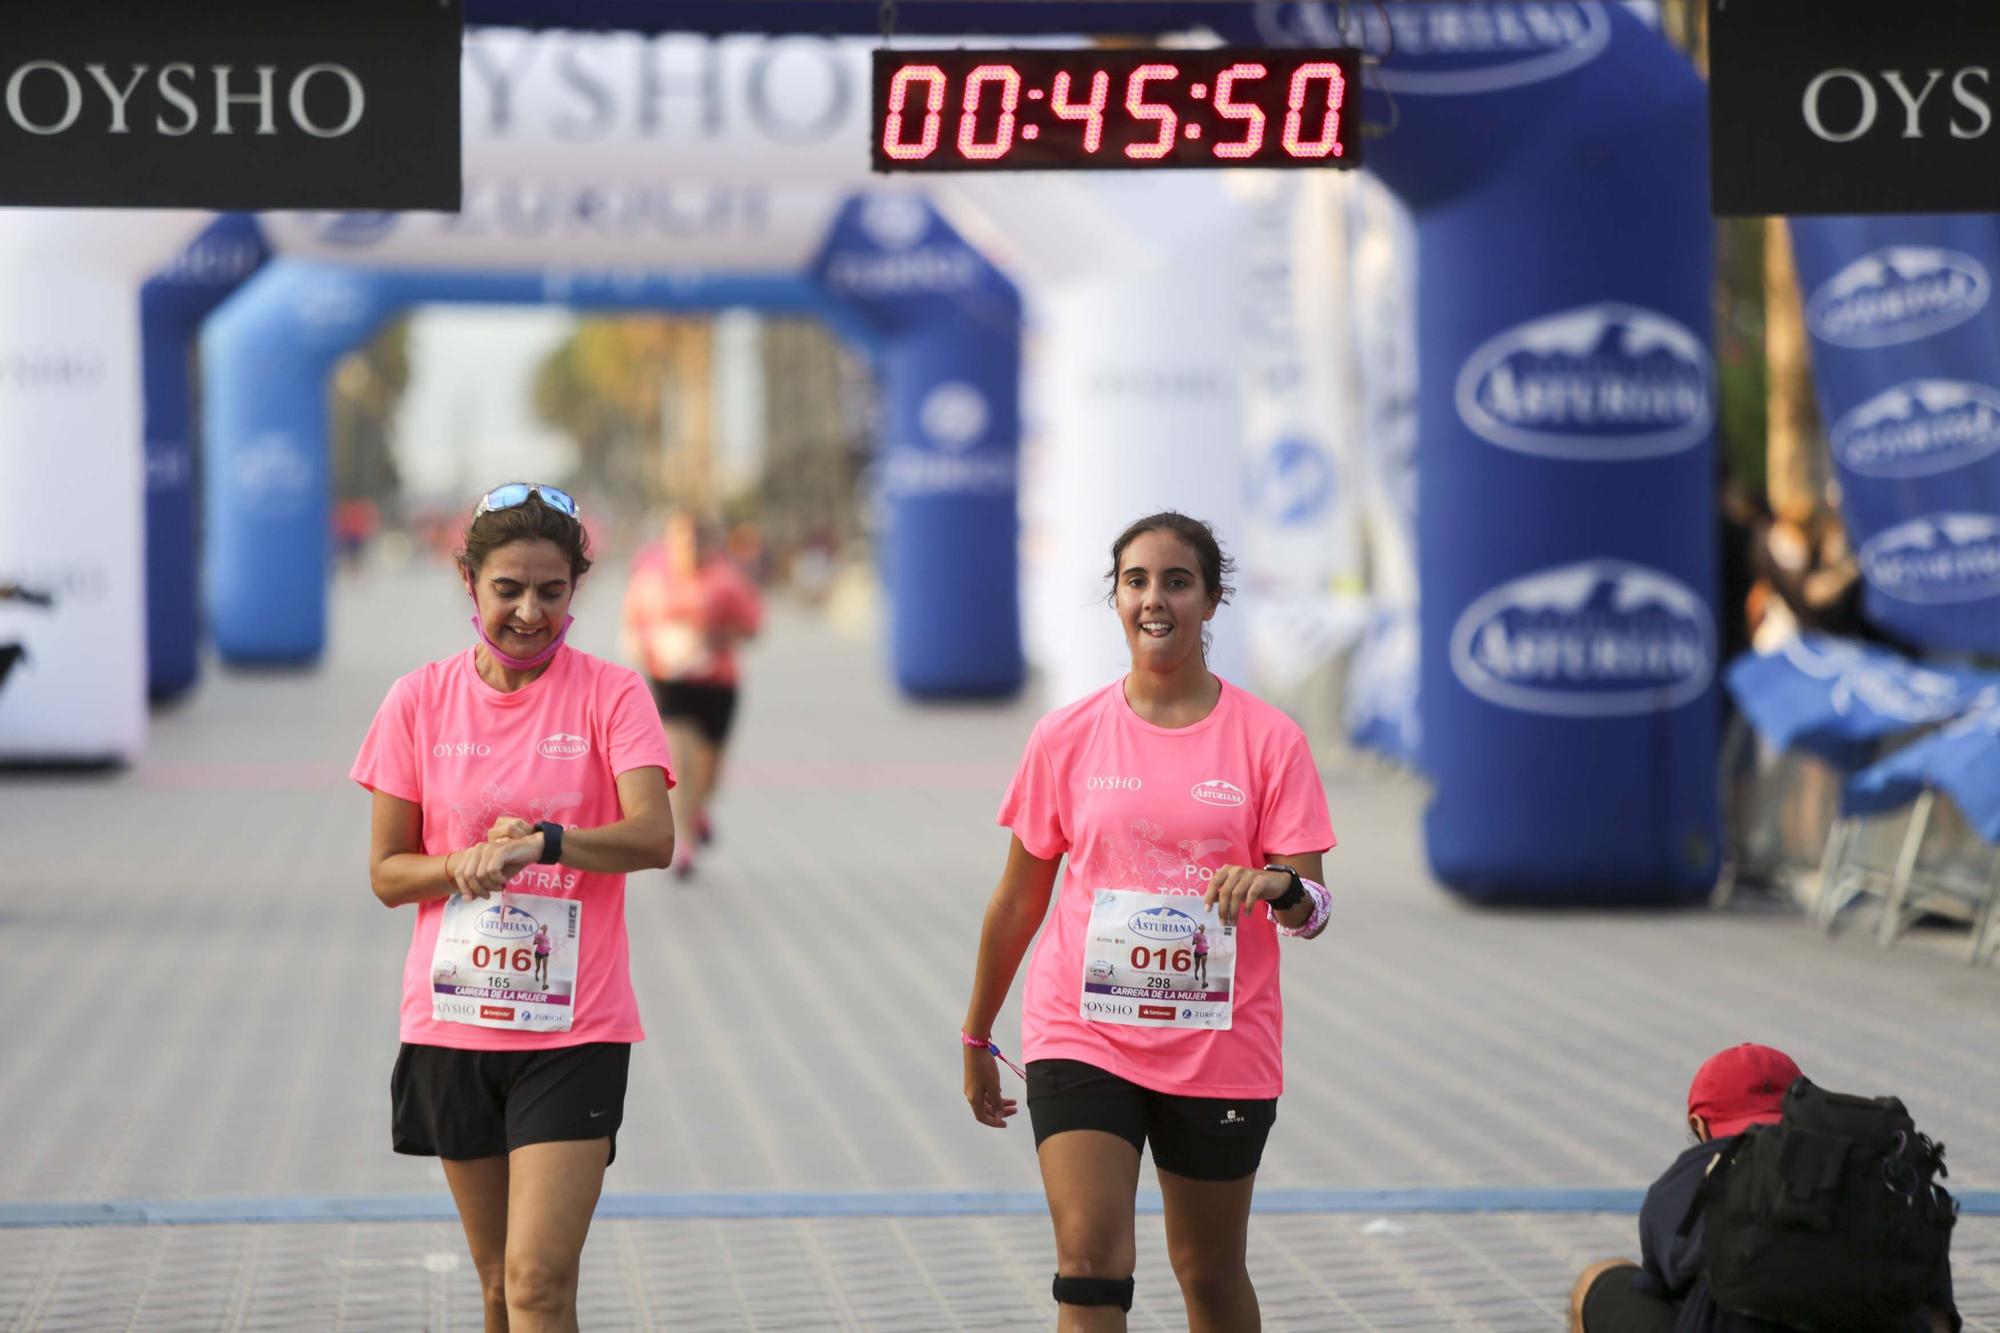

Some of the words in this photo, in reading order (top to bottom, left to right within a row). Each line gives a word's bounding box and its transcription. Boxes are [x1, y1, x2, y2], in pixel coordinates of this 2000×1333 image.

[462, 30, 856, 147] YSHO
[6, 60, 365, 137] OYSHO
[433, 742, 491, 758] OYSHO
[542, 742, 587, 754] ASTURIANA
[1087, 776, 1142, 791] OYSHO
[1194, 787, 1243, 803] ASTURIANA
[510, 870, 576, 889] OTRAS
[1185, 864, 1215, 881] PO
[1133, 917, 1193, 933] ASTURIANA
[472, 945, 533, 972] 016
[1130, 946, 1192, 972] 016
[487, 976, 510, 989] 165
[1146, 976, 1171, 989] 298
[454, 986, 490, 998] CARRERA
[490, 990, 503, 998] DE
[503, 991, 516, 1000] LA
[516, 992, 548, 1002] MUJER
[1110, 986, 1150, 998] CARRERA
[1151, 990, 1164, 998] DE
[1164, 991, 1176, 1000] LA
[1177, 992, 1208, 1001] MUJER
[437, 1002, 476, 1016] OYSHO
[1086, 1001, 1133, 1016] OYSHO
